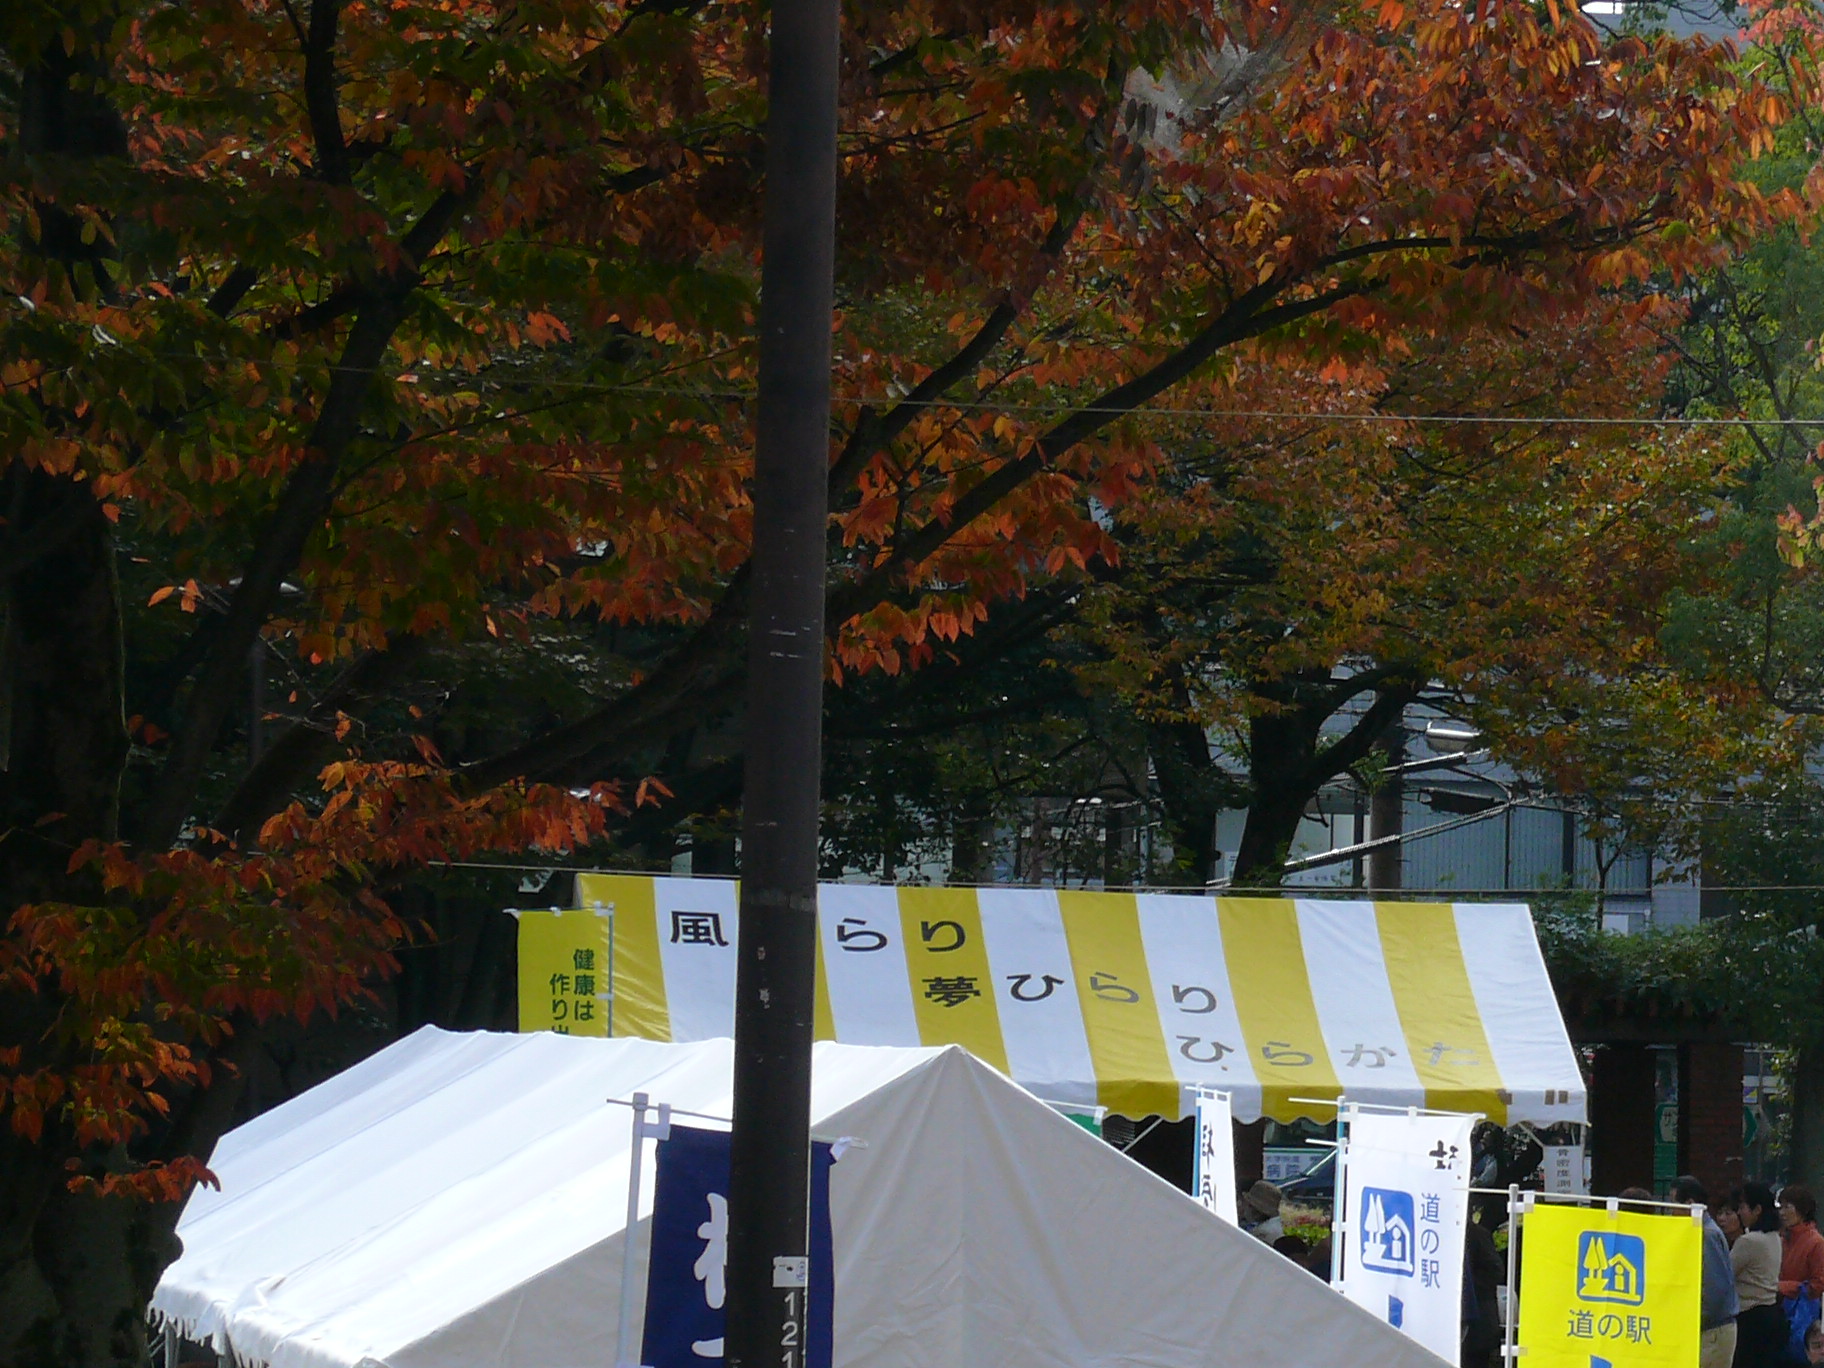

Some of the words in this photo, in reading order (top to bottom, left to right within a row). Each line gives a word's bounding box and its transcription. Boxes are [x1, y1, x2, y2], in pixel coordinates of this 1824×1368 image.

[670, 910, 967, 953] 風らり
[573, 948, 596, 1021] 健康は
[922, 972, 1218, 1015] 夢ひらり
[1177, 1034, 1482, 1069] ひらかた
[1420, 1191, 1441, 1289] 道の駅
[1566, 1309, 1652, 1345] 道の駅
